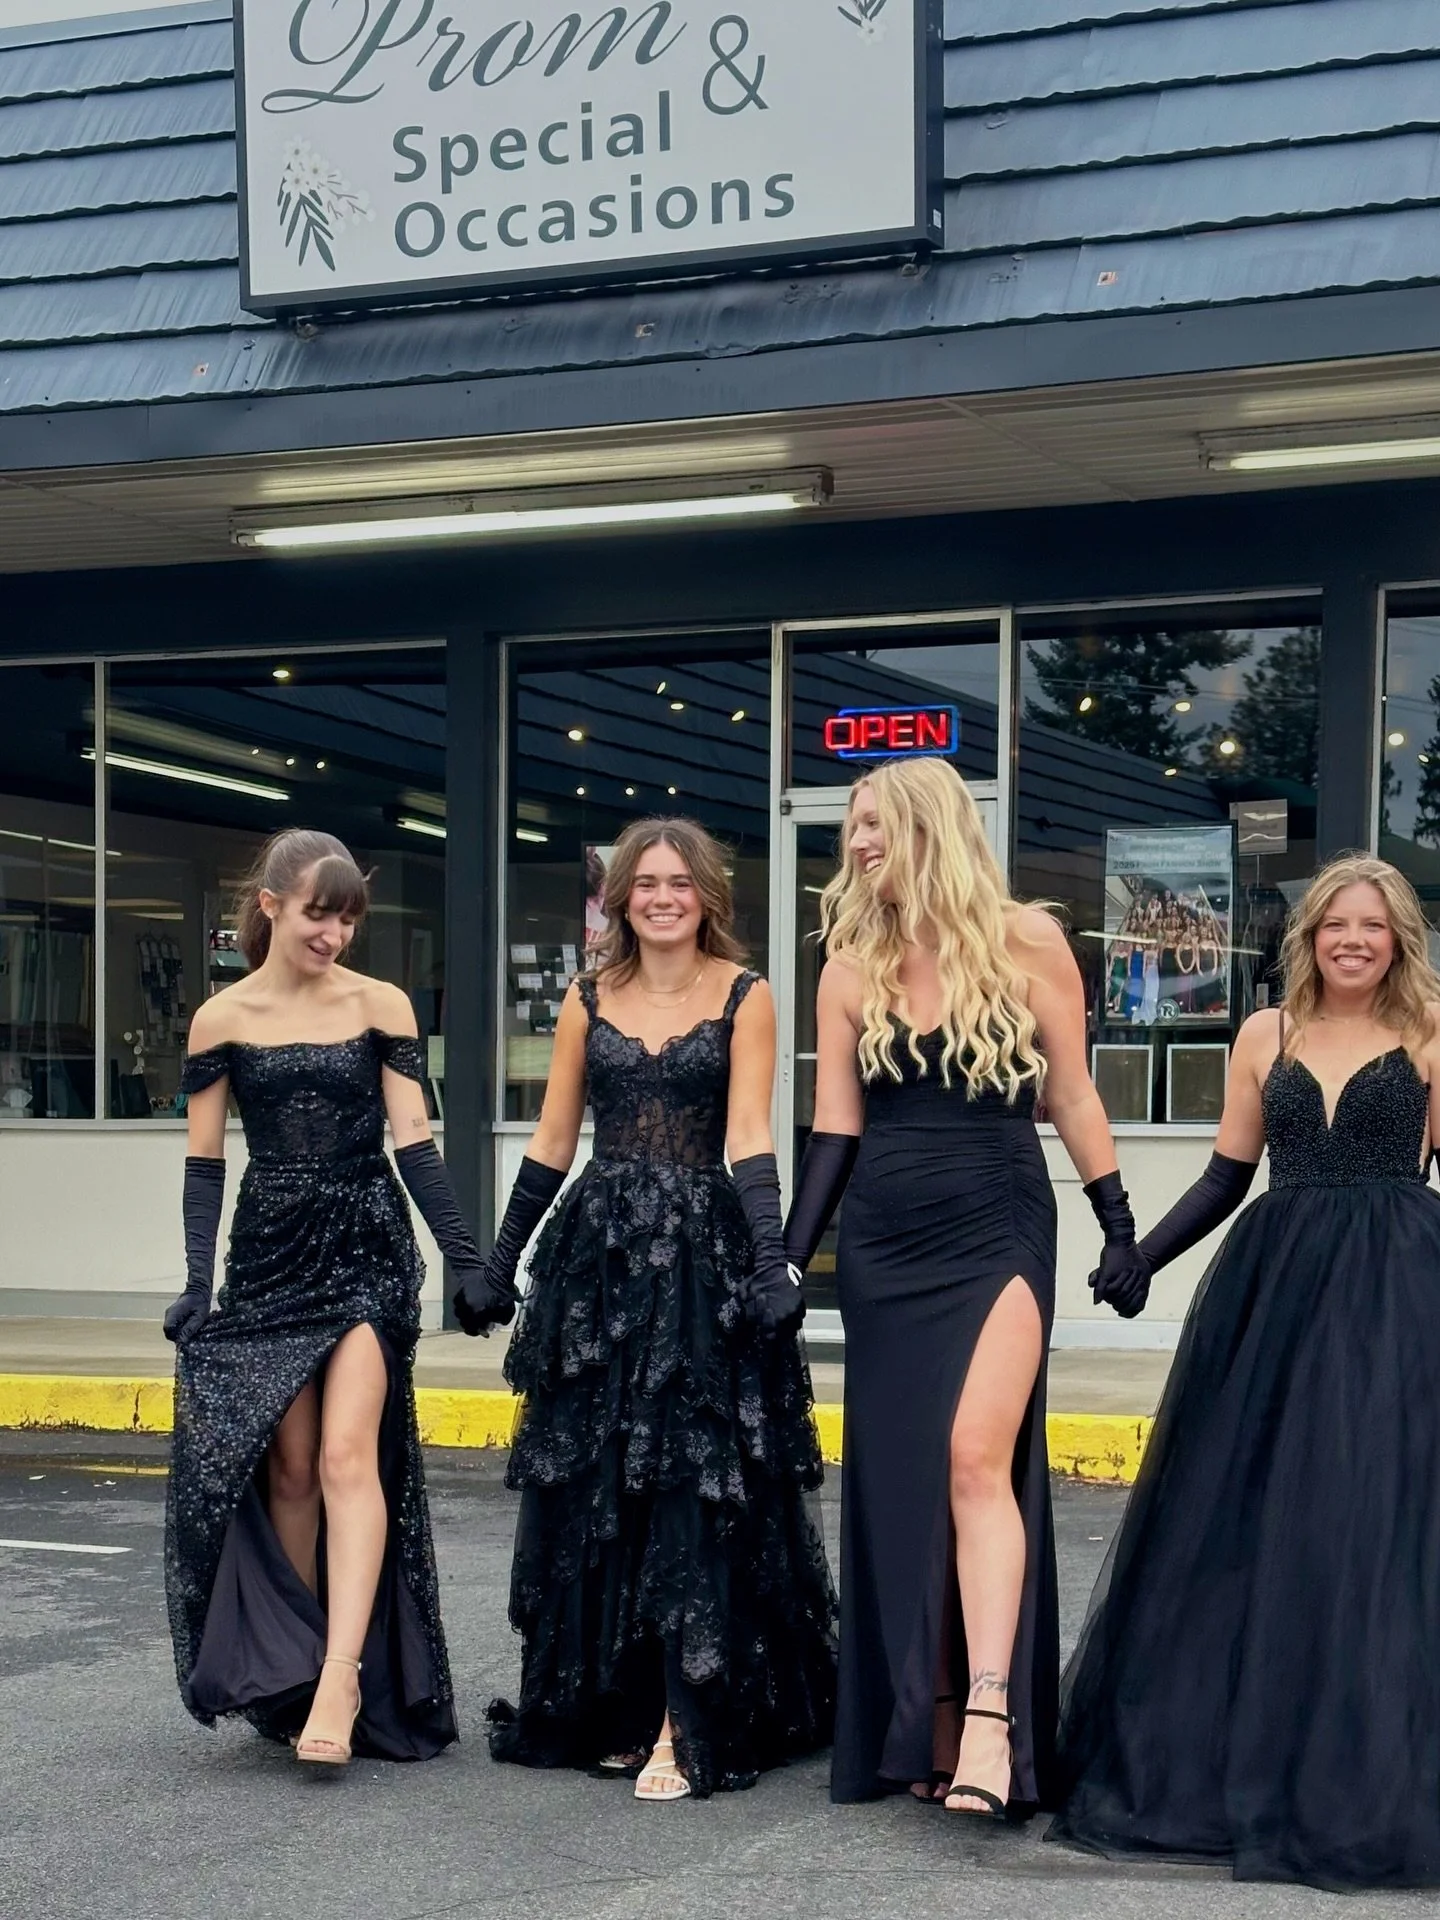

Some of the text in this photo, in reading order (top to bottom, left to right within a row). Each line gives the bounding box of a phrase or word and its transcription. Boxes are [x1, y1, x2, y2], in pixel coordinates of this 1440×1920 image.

[262, 0, 770, 115] Prom &
[392, 90, 673, 195] Special
[394, 172, 796, 259] Occasions
[825, 712, 949, 750] OPEN
